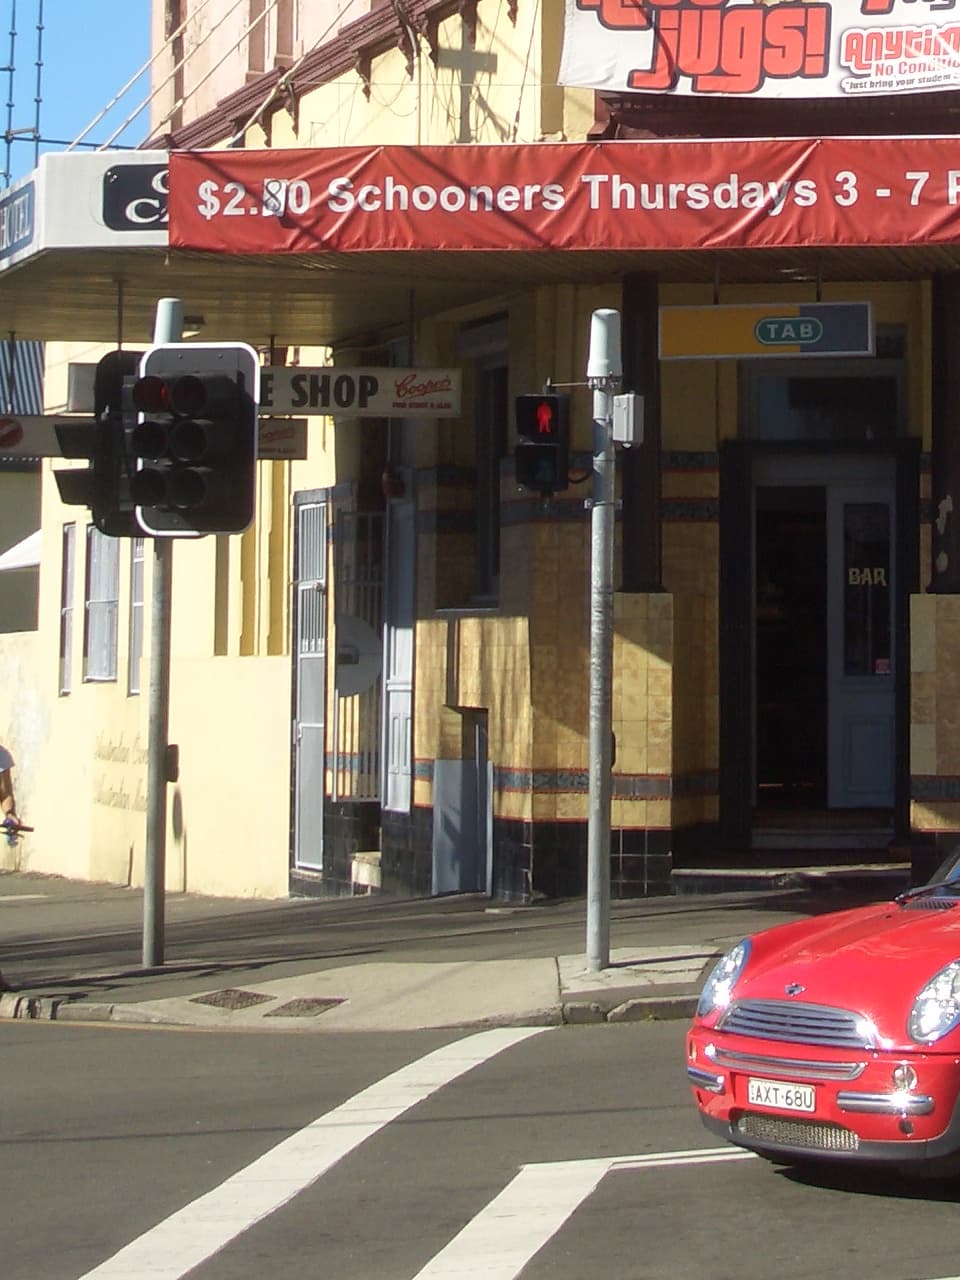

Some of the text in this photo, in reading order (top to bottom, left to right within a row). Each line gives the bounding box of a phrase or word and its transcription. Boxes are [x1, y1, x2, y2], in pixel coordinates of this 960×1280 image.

[875, 63, 894, 77] No
[869, 78, 894, 89] bring
[895, 77, 915, 88] your
[328, 174, 565, 213] Schooners
[581, 172, 818, 216] Thursdays
[834, 171, 859, 207] 3
[876, 188, 892, 197] -
[905, 171, 930, 207] 7
[766, 323, 813, 338] TAB
[291, 373, 379, 409] SHOP
[848, 567, 887, 587] BAR
